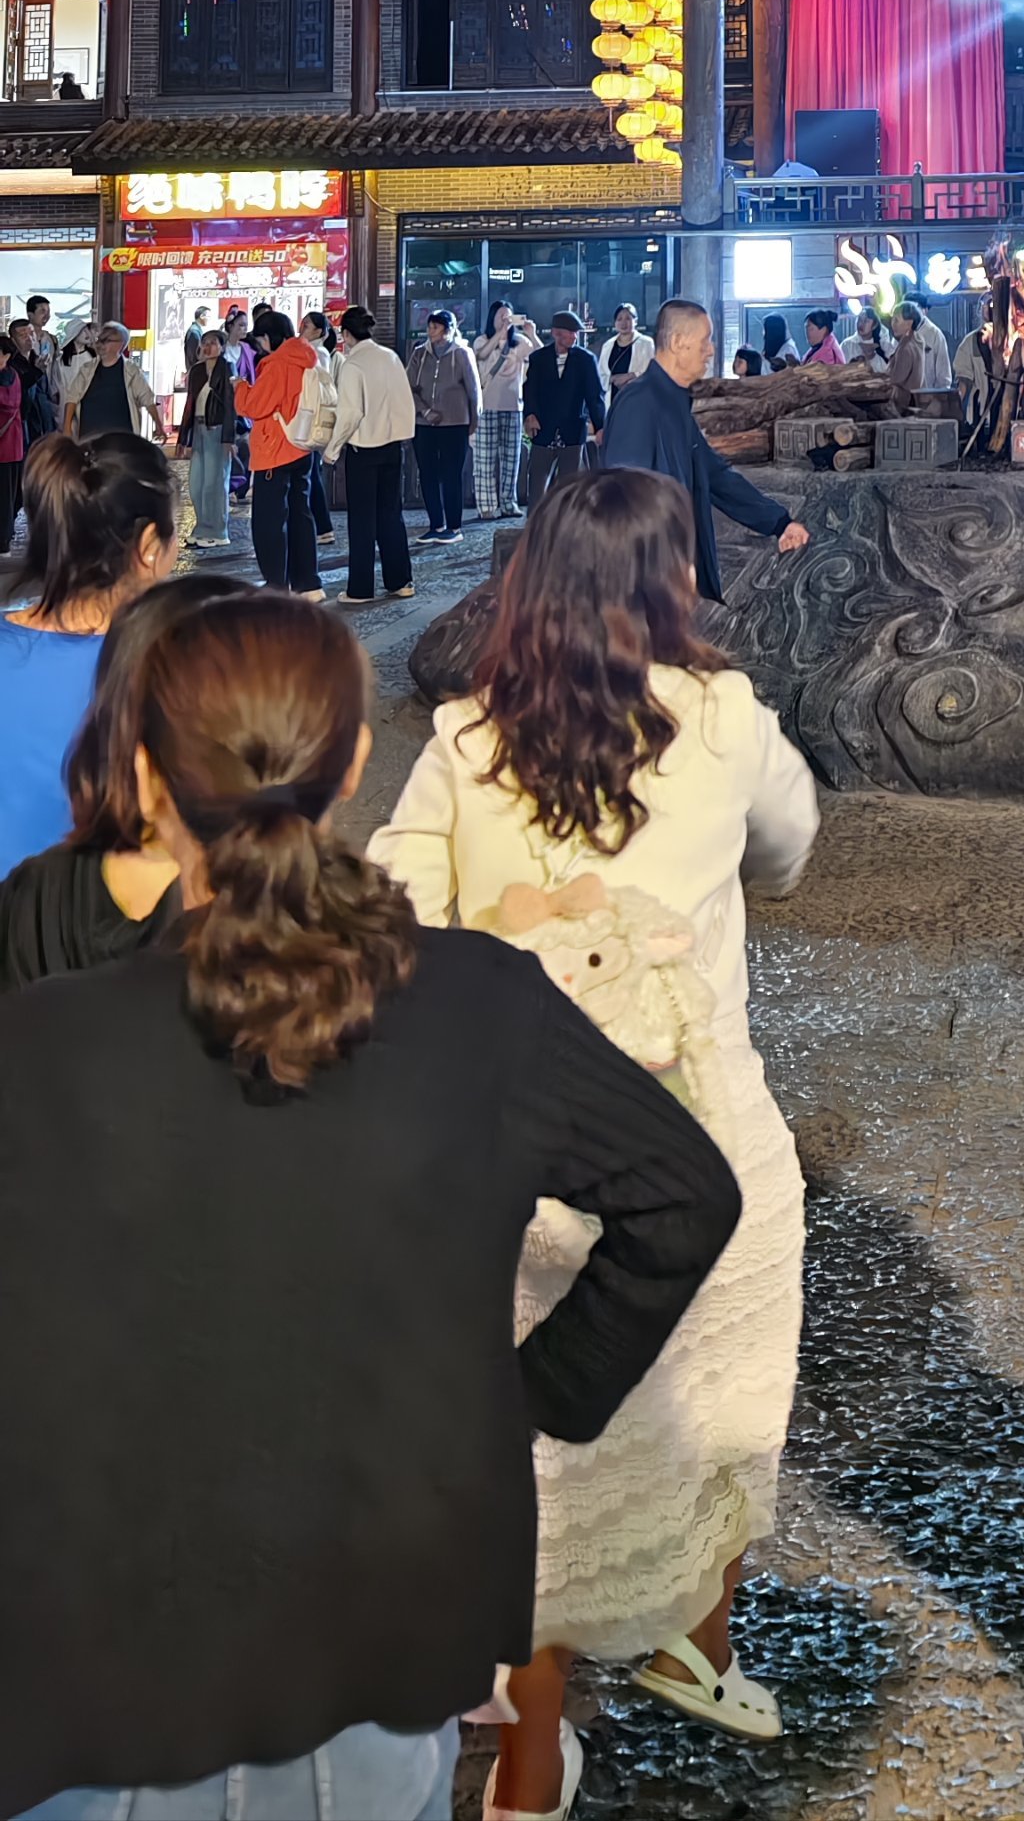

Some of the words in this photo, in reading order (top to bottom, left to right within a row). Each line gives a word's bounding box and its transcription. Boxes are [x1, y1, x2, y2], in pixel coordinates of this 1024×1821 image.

[137, 250, 194, 266] 限时回馈
[197, 248, 286, 264] 充200送50
